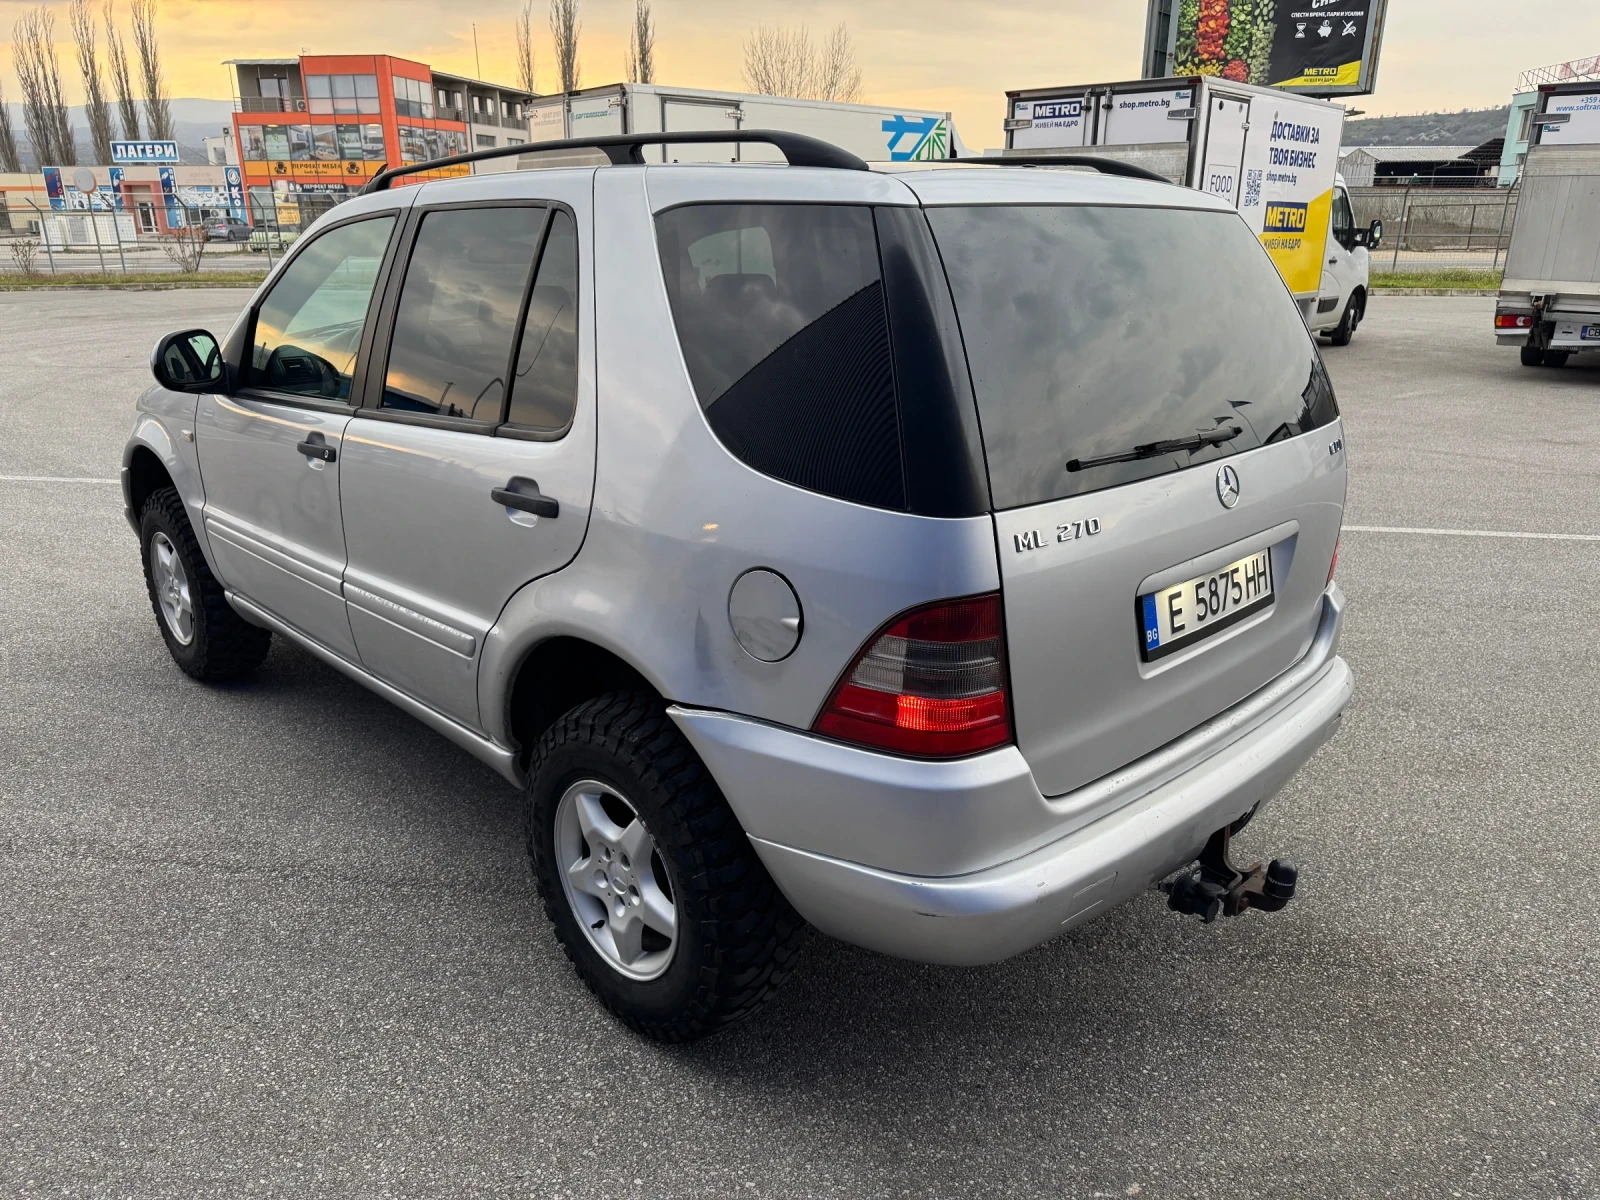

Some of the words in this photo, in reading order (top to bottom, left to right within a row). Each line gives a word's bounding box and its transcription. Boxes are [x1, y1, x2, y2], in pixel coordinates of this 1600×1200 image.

[1035, 103, 1080, 117] METRO
[1119, 98, 1170, 110] shop.metro.bg
[1034, 120, 1053, 128] ЖИВЕЙ
[1063, 120, 1078, 128] ЕДРО
[1270, 121, 1310, 143] ДОСТАВКИ
[1310, 128, 1320, 144] ЗА
[116, 144, 175, 158] ЛАГЕРИ
[1269, 147, 1289, 166] ТВОЯ
[1290, 150, 1317, 169] БИЗНЕС
[1210, 174, 1232, 193] FOOD
[1266, 171, 1297, 186] shop.metro.bg
[1266, 206, 1306, 228] METRO
[1264, 236, 1280, 250] ЖИВЕЙ
[1281, 237, 1288, 249] НА
[1288, 238, 1301, 251] ЕДРО
[1014, 529, 1049, 552] ML
[1057, 516, 1101, 543] 270
[1168, 590, 1186, 635] E
[1195, 567, 1243, 622] 5875
[1147, 628, 1158, 643] BG
